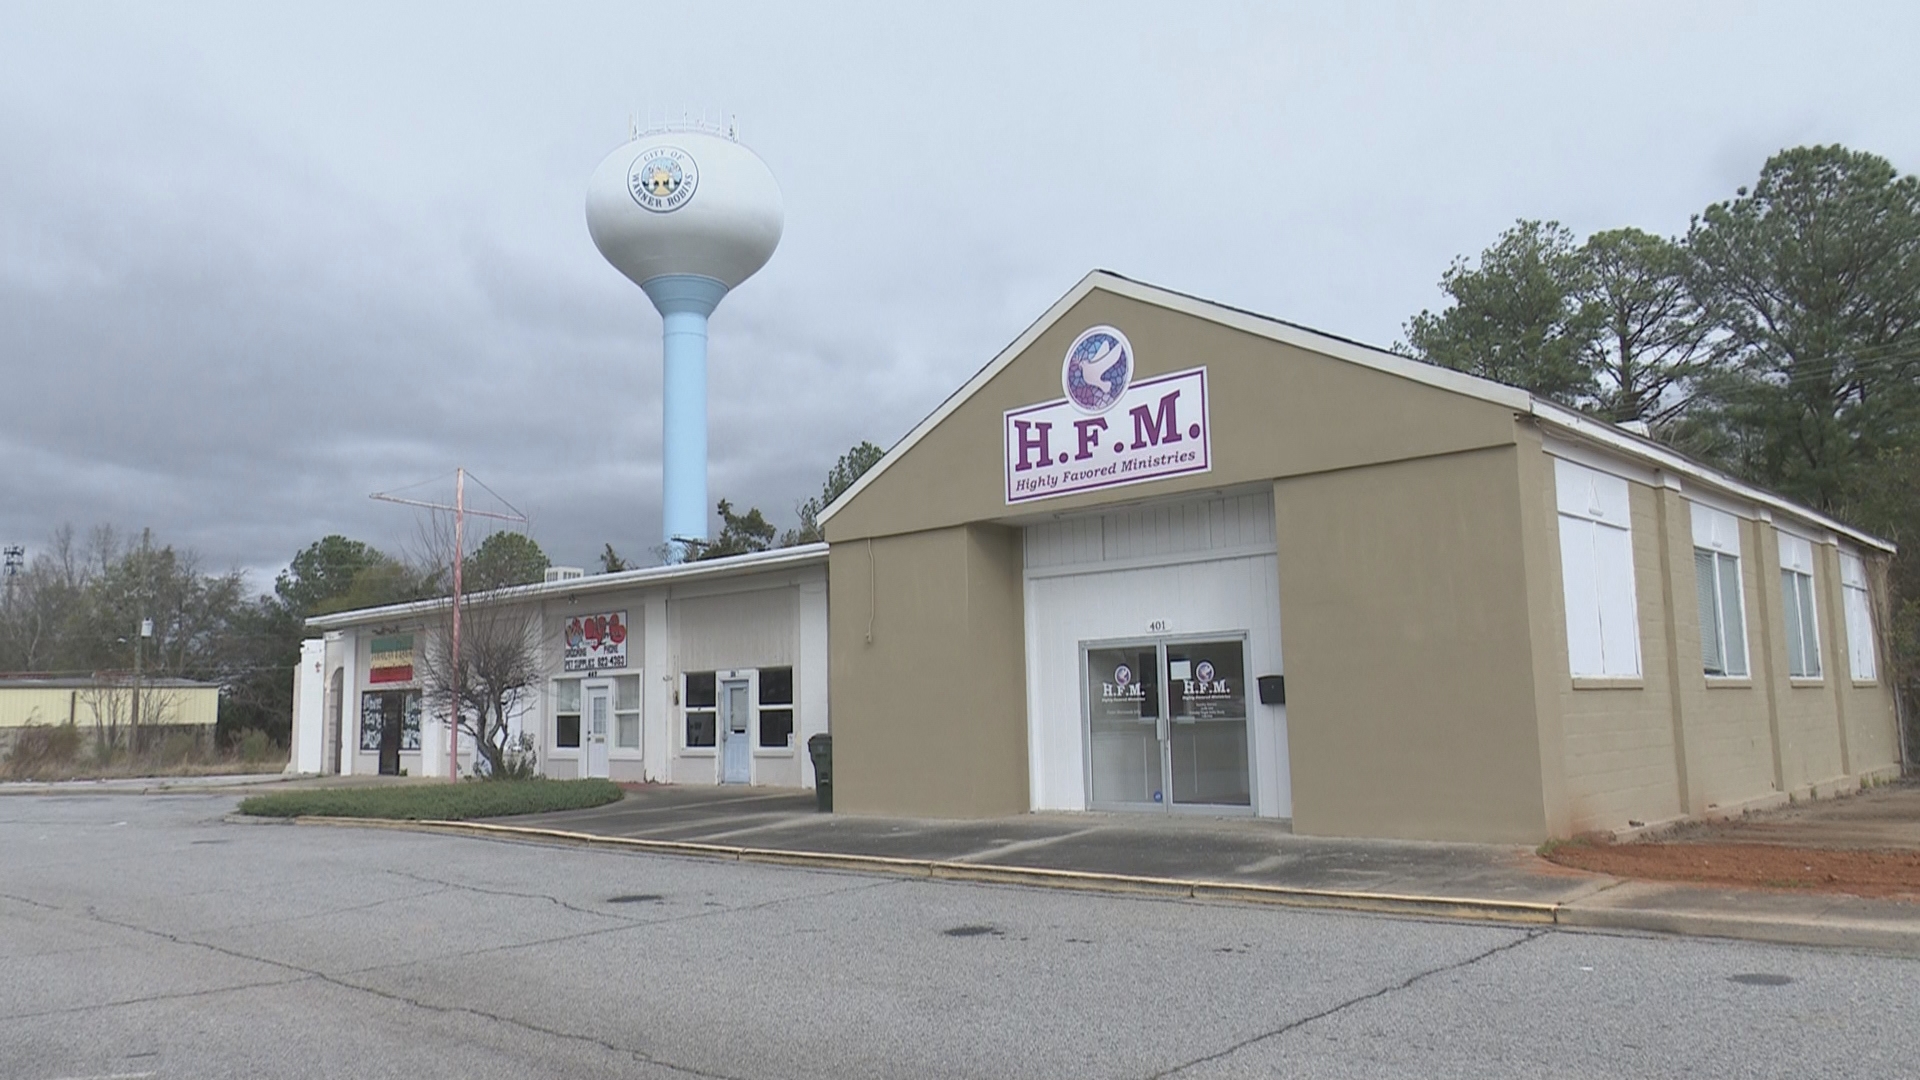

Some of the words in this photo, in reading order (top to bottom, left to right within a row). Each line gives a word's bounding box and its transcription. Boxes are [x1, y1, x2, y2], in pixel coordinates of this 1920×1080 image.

[643, 149, 665, 162] CITY
[670, 150, 685, 161] OF
[632, 172, 662, 208] WARNER
[666, 172, 694, 207] ROBINS
[1016, 474, 1058, 492] Highly
[1062, 464, 1117, 483] Favored
[1121, 450, 1196, 473] Ministries
[1150, 620, 1165, 631] 401
